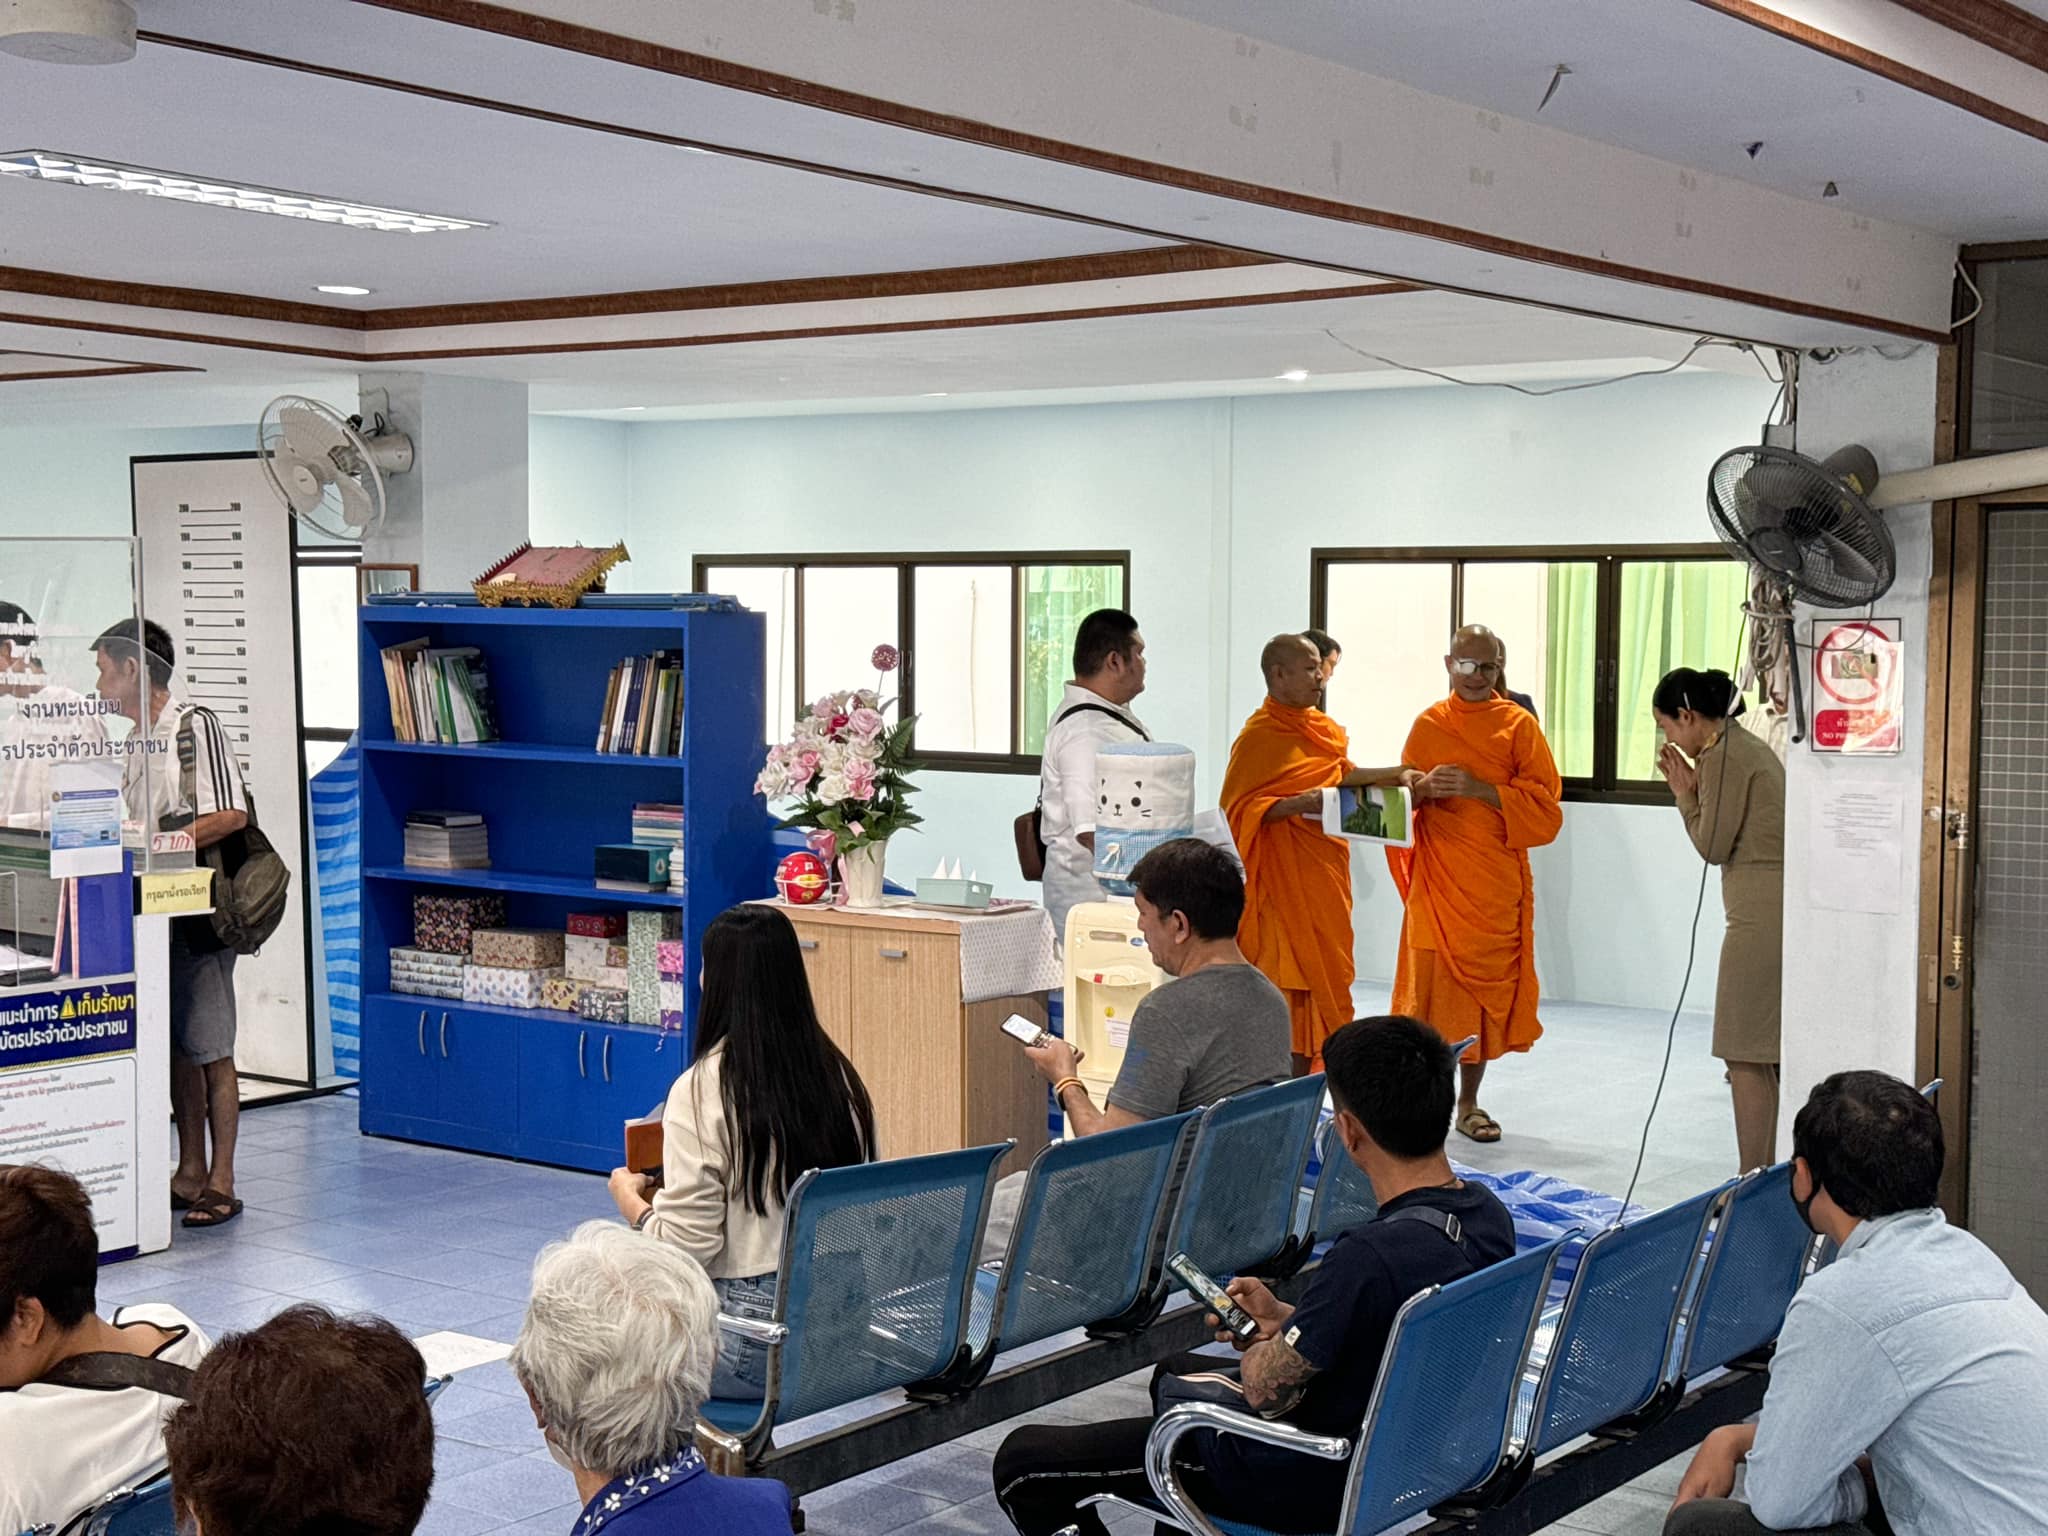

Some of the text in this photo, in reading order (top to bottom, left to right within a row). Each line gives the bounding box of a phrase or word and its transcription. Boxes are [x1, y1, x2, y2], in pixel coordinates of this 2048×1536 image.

[22, 693, 121, 719] งานทะเบียน
[77, 991, 135, 1016] เก็บรักษา
[0, 1020, 128, 1050] บัตรประจำตัวประชาชน
